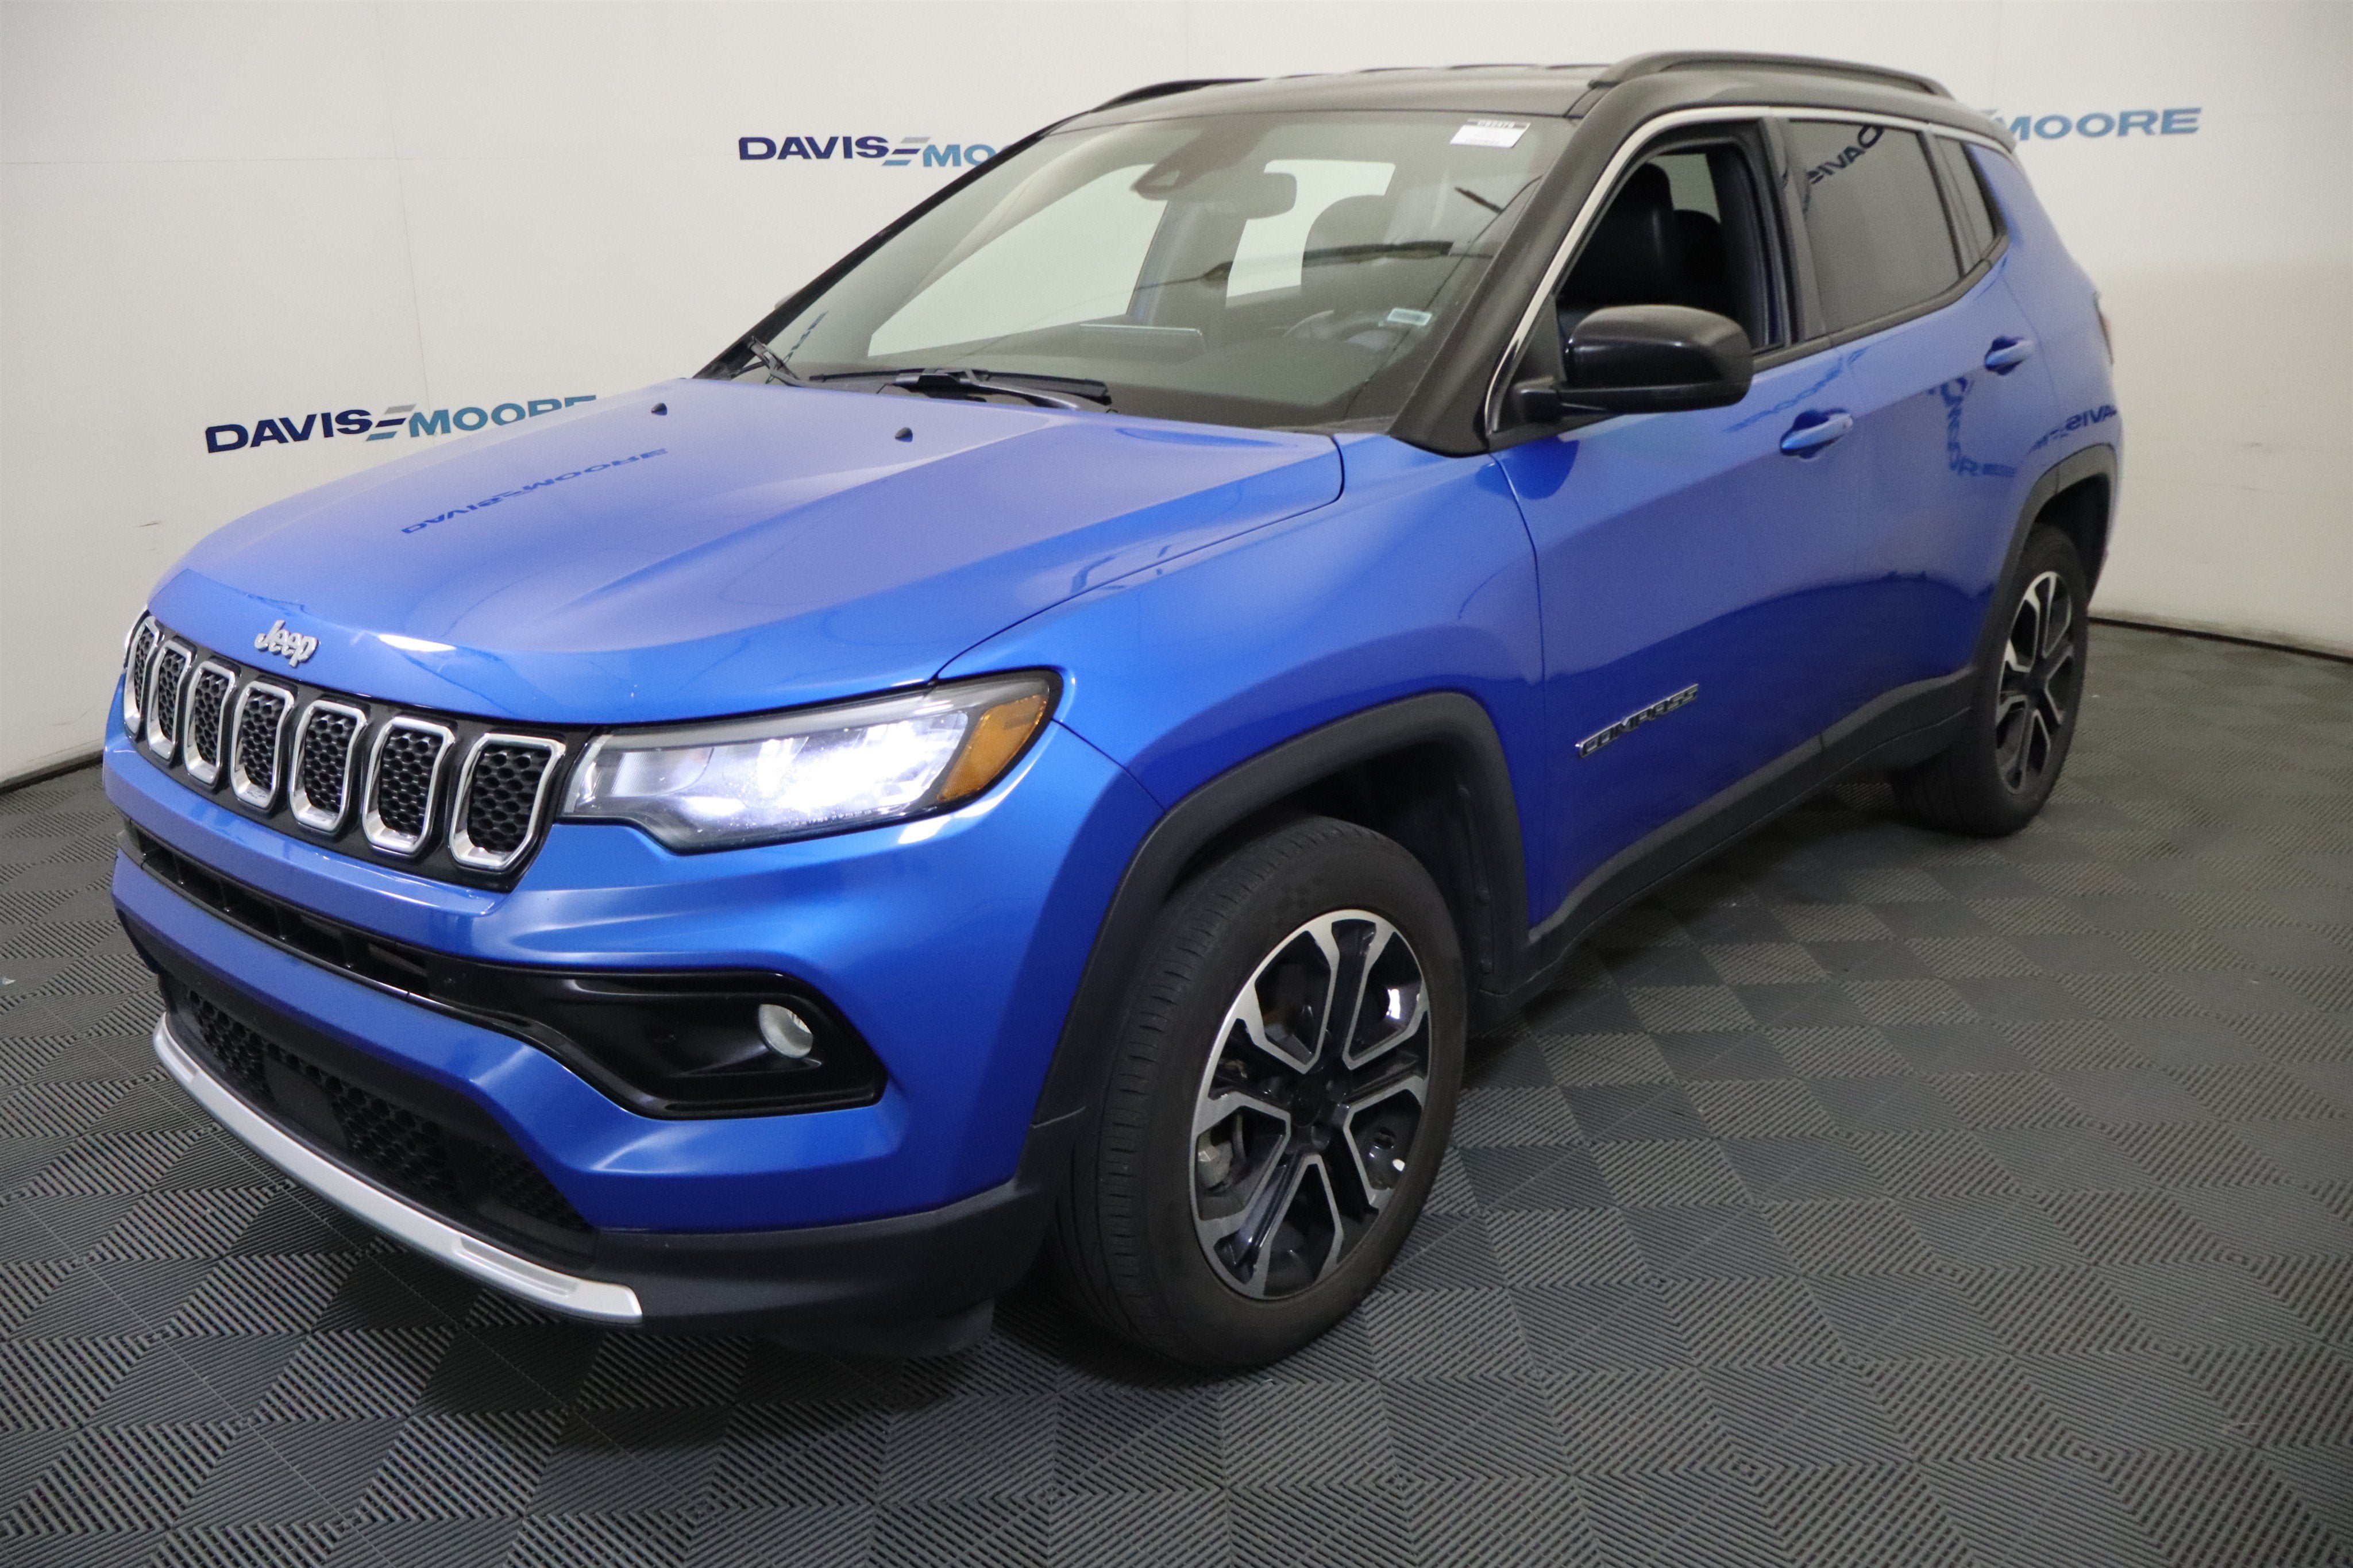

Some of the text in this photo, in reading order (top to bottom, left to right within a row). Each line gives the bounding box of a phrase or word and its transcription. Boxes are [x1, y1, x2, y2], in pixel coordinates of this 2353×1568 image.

[739, 136, 890, 160] DAVIS
[205, 408, 373, 454] DAVIS
[254, 619, 319, 668] Jeep
